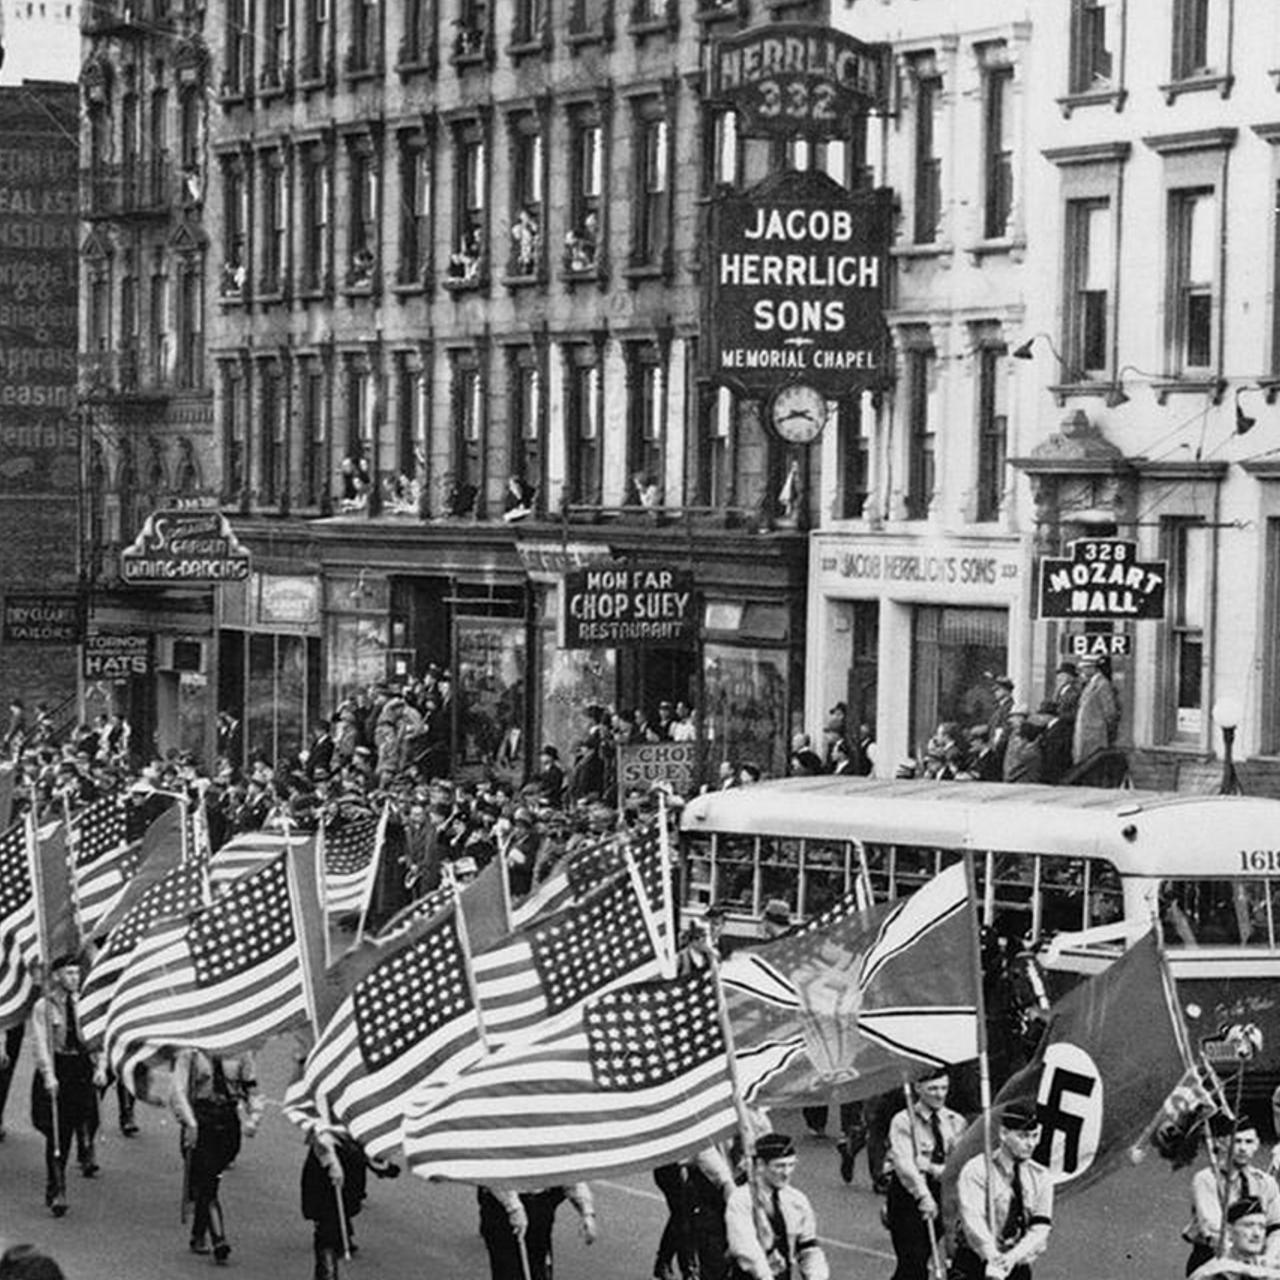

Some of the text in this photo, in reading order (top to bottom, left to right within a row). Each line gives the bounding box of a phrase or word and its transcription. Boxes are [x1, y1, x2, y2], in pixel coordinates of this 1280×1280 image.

[759, 81, 837, 119] 332
[744, 208, 853, 241] JACOB
[720, 253, 879, 287] HERRLICH
[753, 300, 846, 331] SONS
[721, 348, 877, 369] MEMORIAL CHAPEL
[1084, 543, 1126, 561] 328
[632, 571, 674, 590] FAR
[960, 557, 998, 584] SONS
[1049, 562, 1162, 595] MOZART
[570, 592, 690, 620] CHOP SUEY
[1071, 590, 1139, 613] HALL
[578, 622, 684, 640] RESTAURANT
[1072, 634, 1126, 656] BAR
[85, 656, 148, 676] HATS
